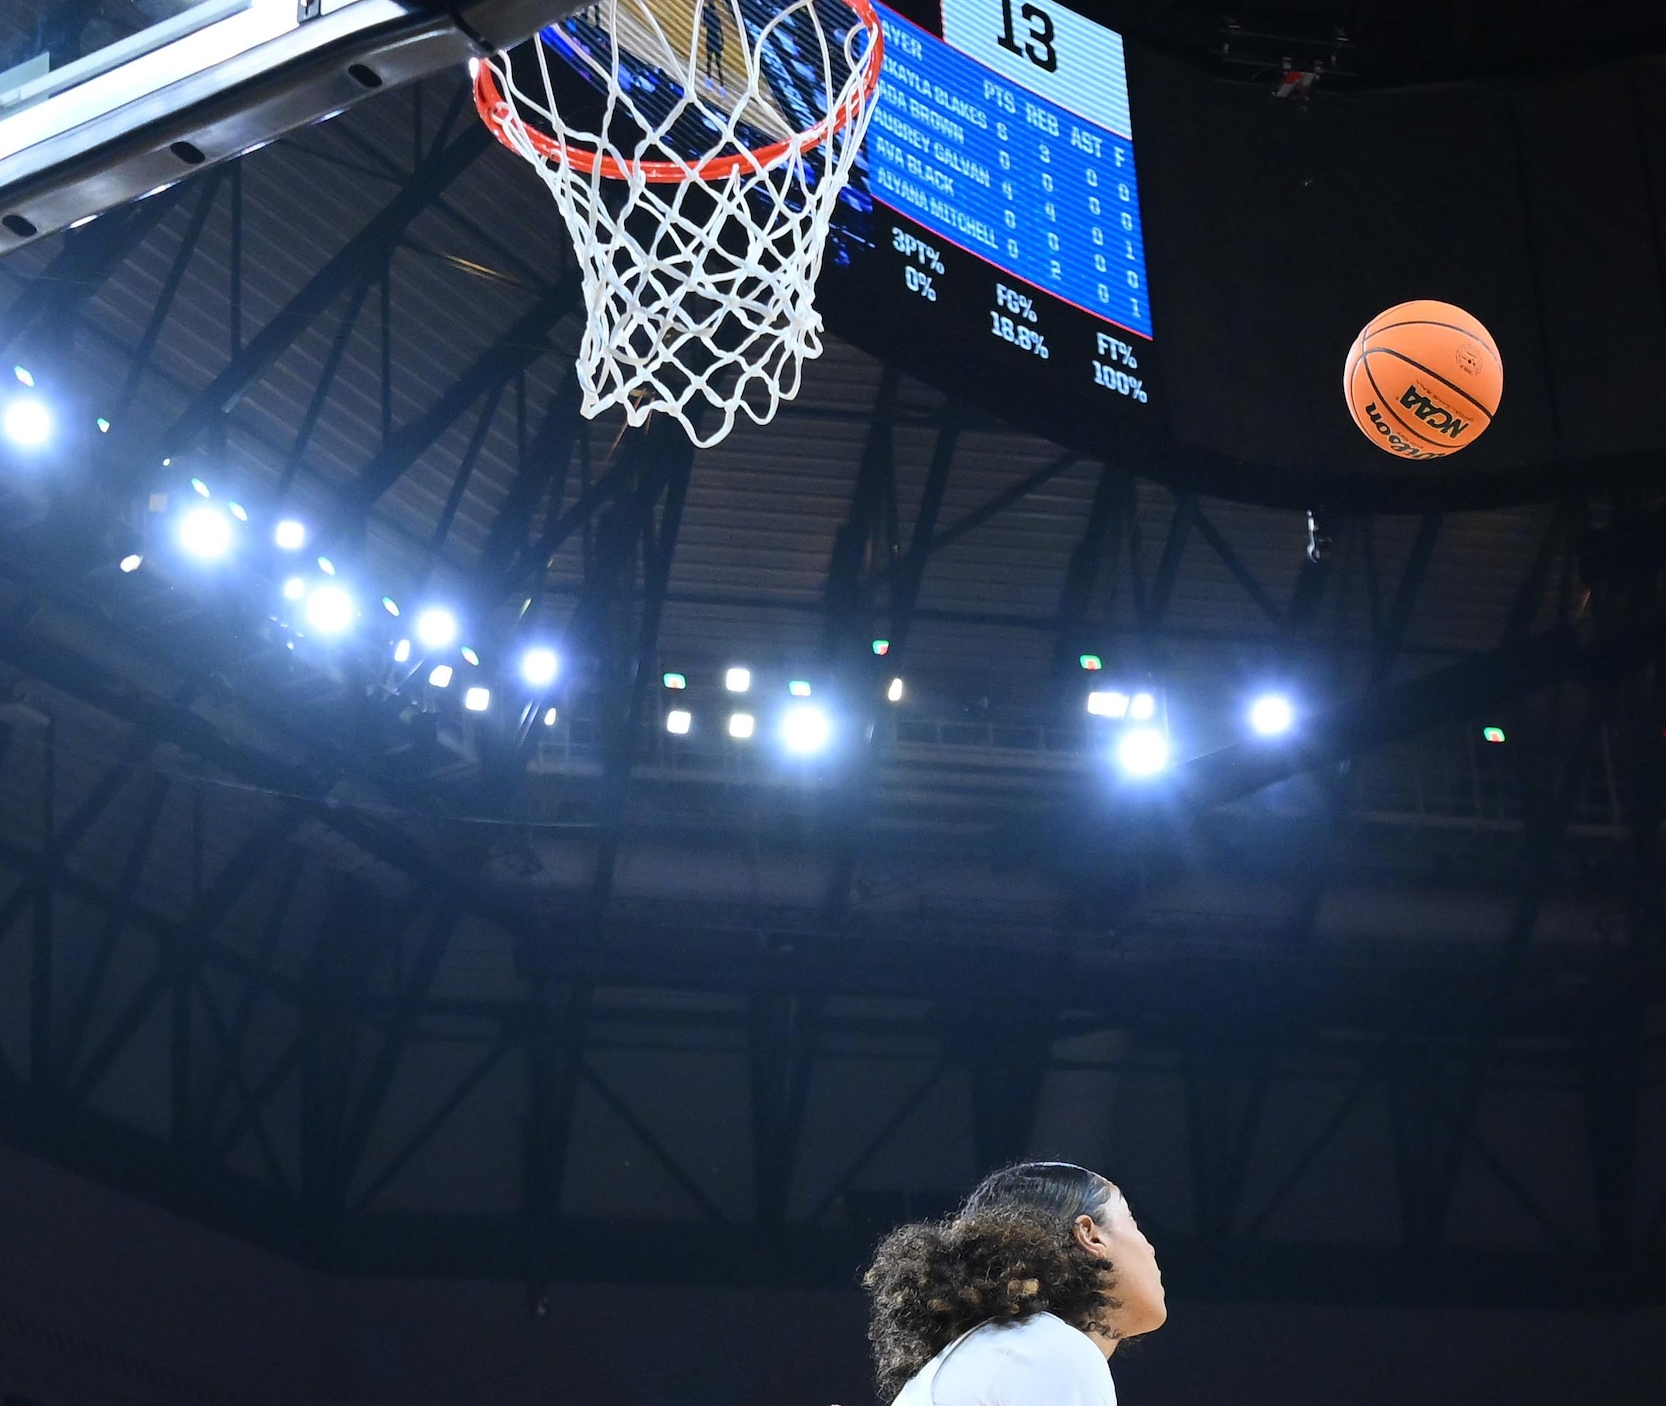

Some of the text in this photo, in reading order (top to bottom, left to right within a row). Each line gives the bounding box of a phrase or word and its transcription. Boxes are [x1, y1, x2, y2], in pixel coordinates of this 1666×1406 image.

[997, 0, 1057, 73] 13
[882, 19, 1125, 167] AYER PTS REB AST F
[879, 79, 1133, 231] ADA BROWN 0 0 0 0
[883, 54, 933, 99] IKAYLA
[933, 85, 988, 130] BLAKES
[1086, 168, 1098, 187] 0
[1118, 183, 1130, 202] 0
[873, 106, 1135, 260] AUBREY GALVAN 4 4 0 1
[876, 137, 1139, 289] AVA BLACK 0 0 0 0
[878, 167, 1141, 318] AIYANA MITCHELL 0 2 0 1
[891, 226, 945, 275] 3PT%
[905, 265, 937, 302] 0%
[996, 282, 1038, 323] FG%
[989, 310, 1050, 360] 18.8%
[1096, 331, 1138, 369] FT%
[1092, 360, 1148, 403] 100%
[1399, 384, 1470, 439] NCAA
